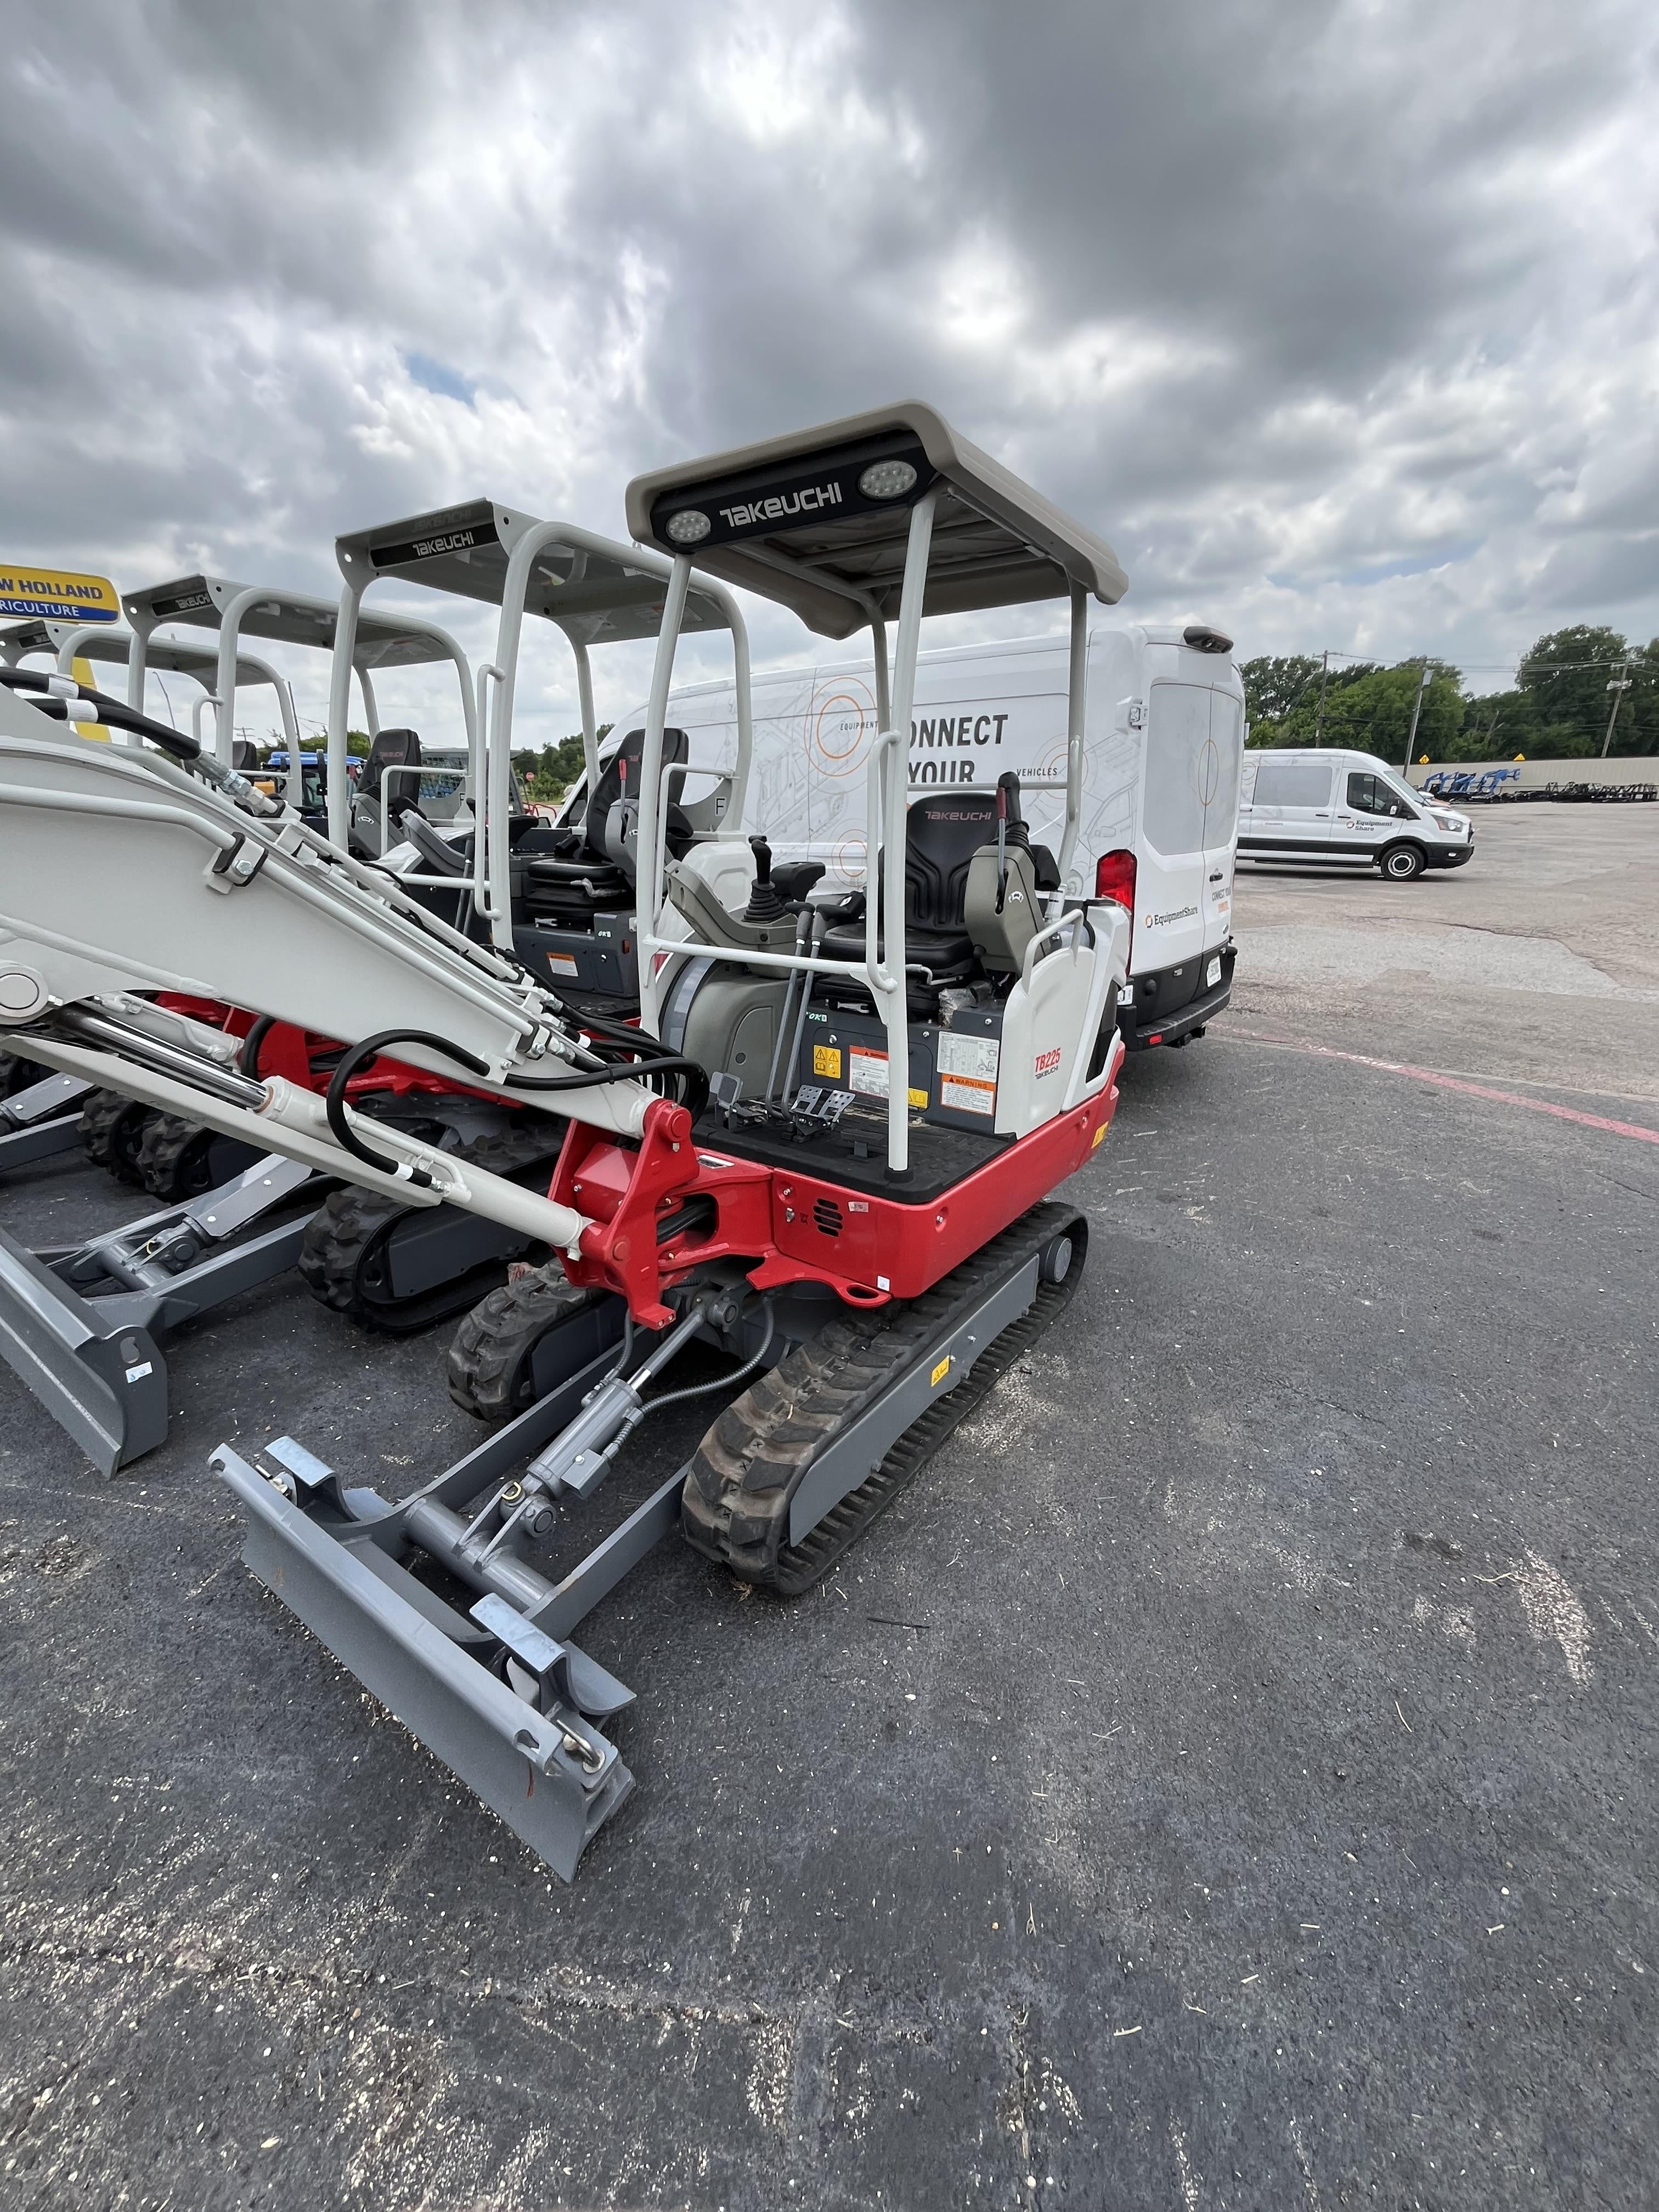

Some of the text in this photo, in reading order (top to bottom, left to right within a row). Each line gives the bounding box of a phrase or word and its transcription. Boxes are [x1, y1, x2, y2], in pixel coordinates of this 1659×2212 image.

[719, 482, 843, 527] TAKEUCHI
[412, 531, 475, 556] TAKEUCHI
[18, 579, 103, 600] HOLLAND
[175, 593, 211, 609] TAKEUCHI
[840, 720, 878, 731] EQUIPMENT
[1017, 768, 1058, 777] VEHICLES
[716, 798, 725, 815] F
[924, 810, 992, 821] TAKEUCHI
[1154, 906, 1198, 926] EquipmentShare
[1035, 1047, 1061, 1073] TB225
[955, 1079, 988, 1089] WARNING
